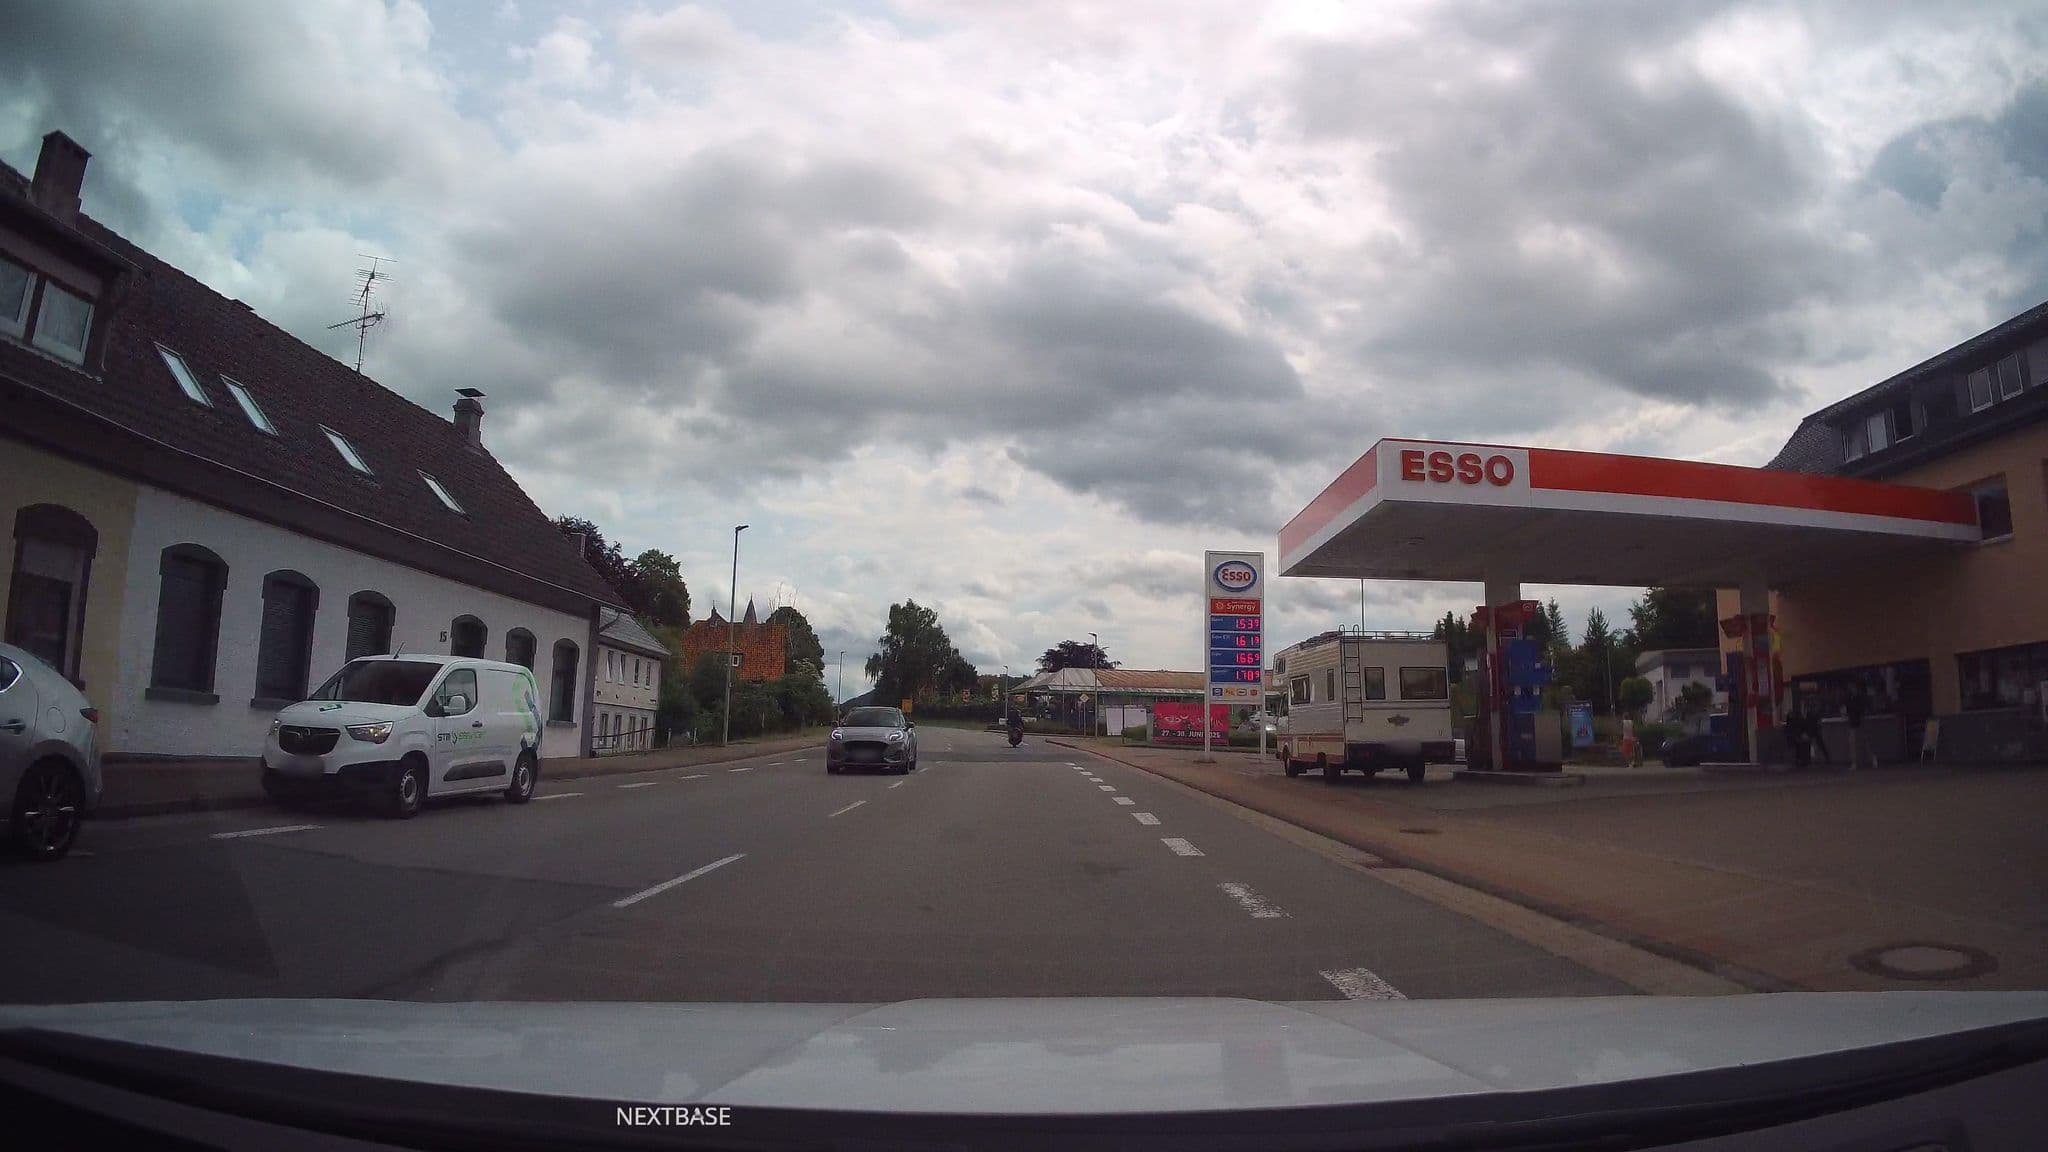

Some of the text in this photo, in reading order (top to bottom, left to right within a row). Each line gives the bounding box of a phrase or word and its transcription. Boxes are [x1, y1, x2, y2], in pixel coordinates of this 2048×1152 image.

[1401, 449, 1515, 487] ESSO
[1226, 602, 1256, 612] Synergy
[440, 631, 447, 642] 15
[1188, 730, 1204, 738] JUNI
